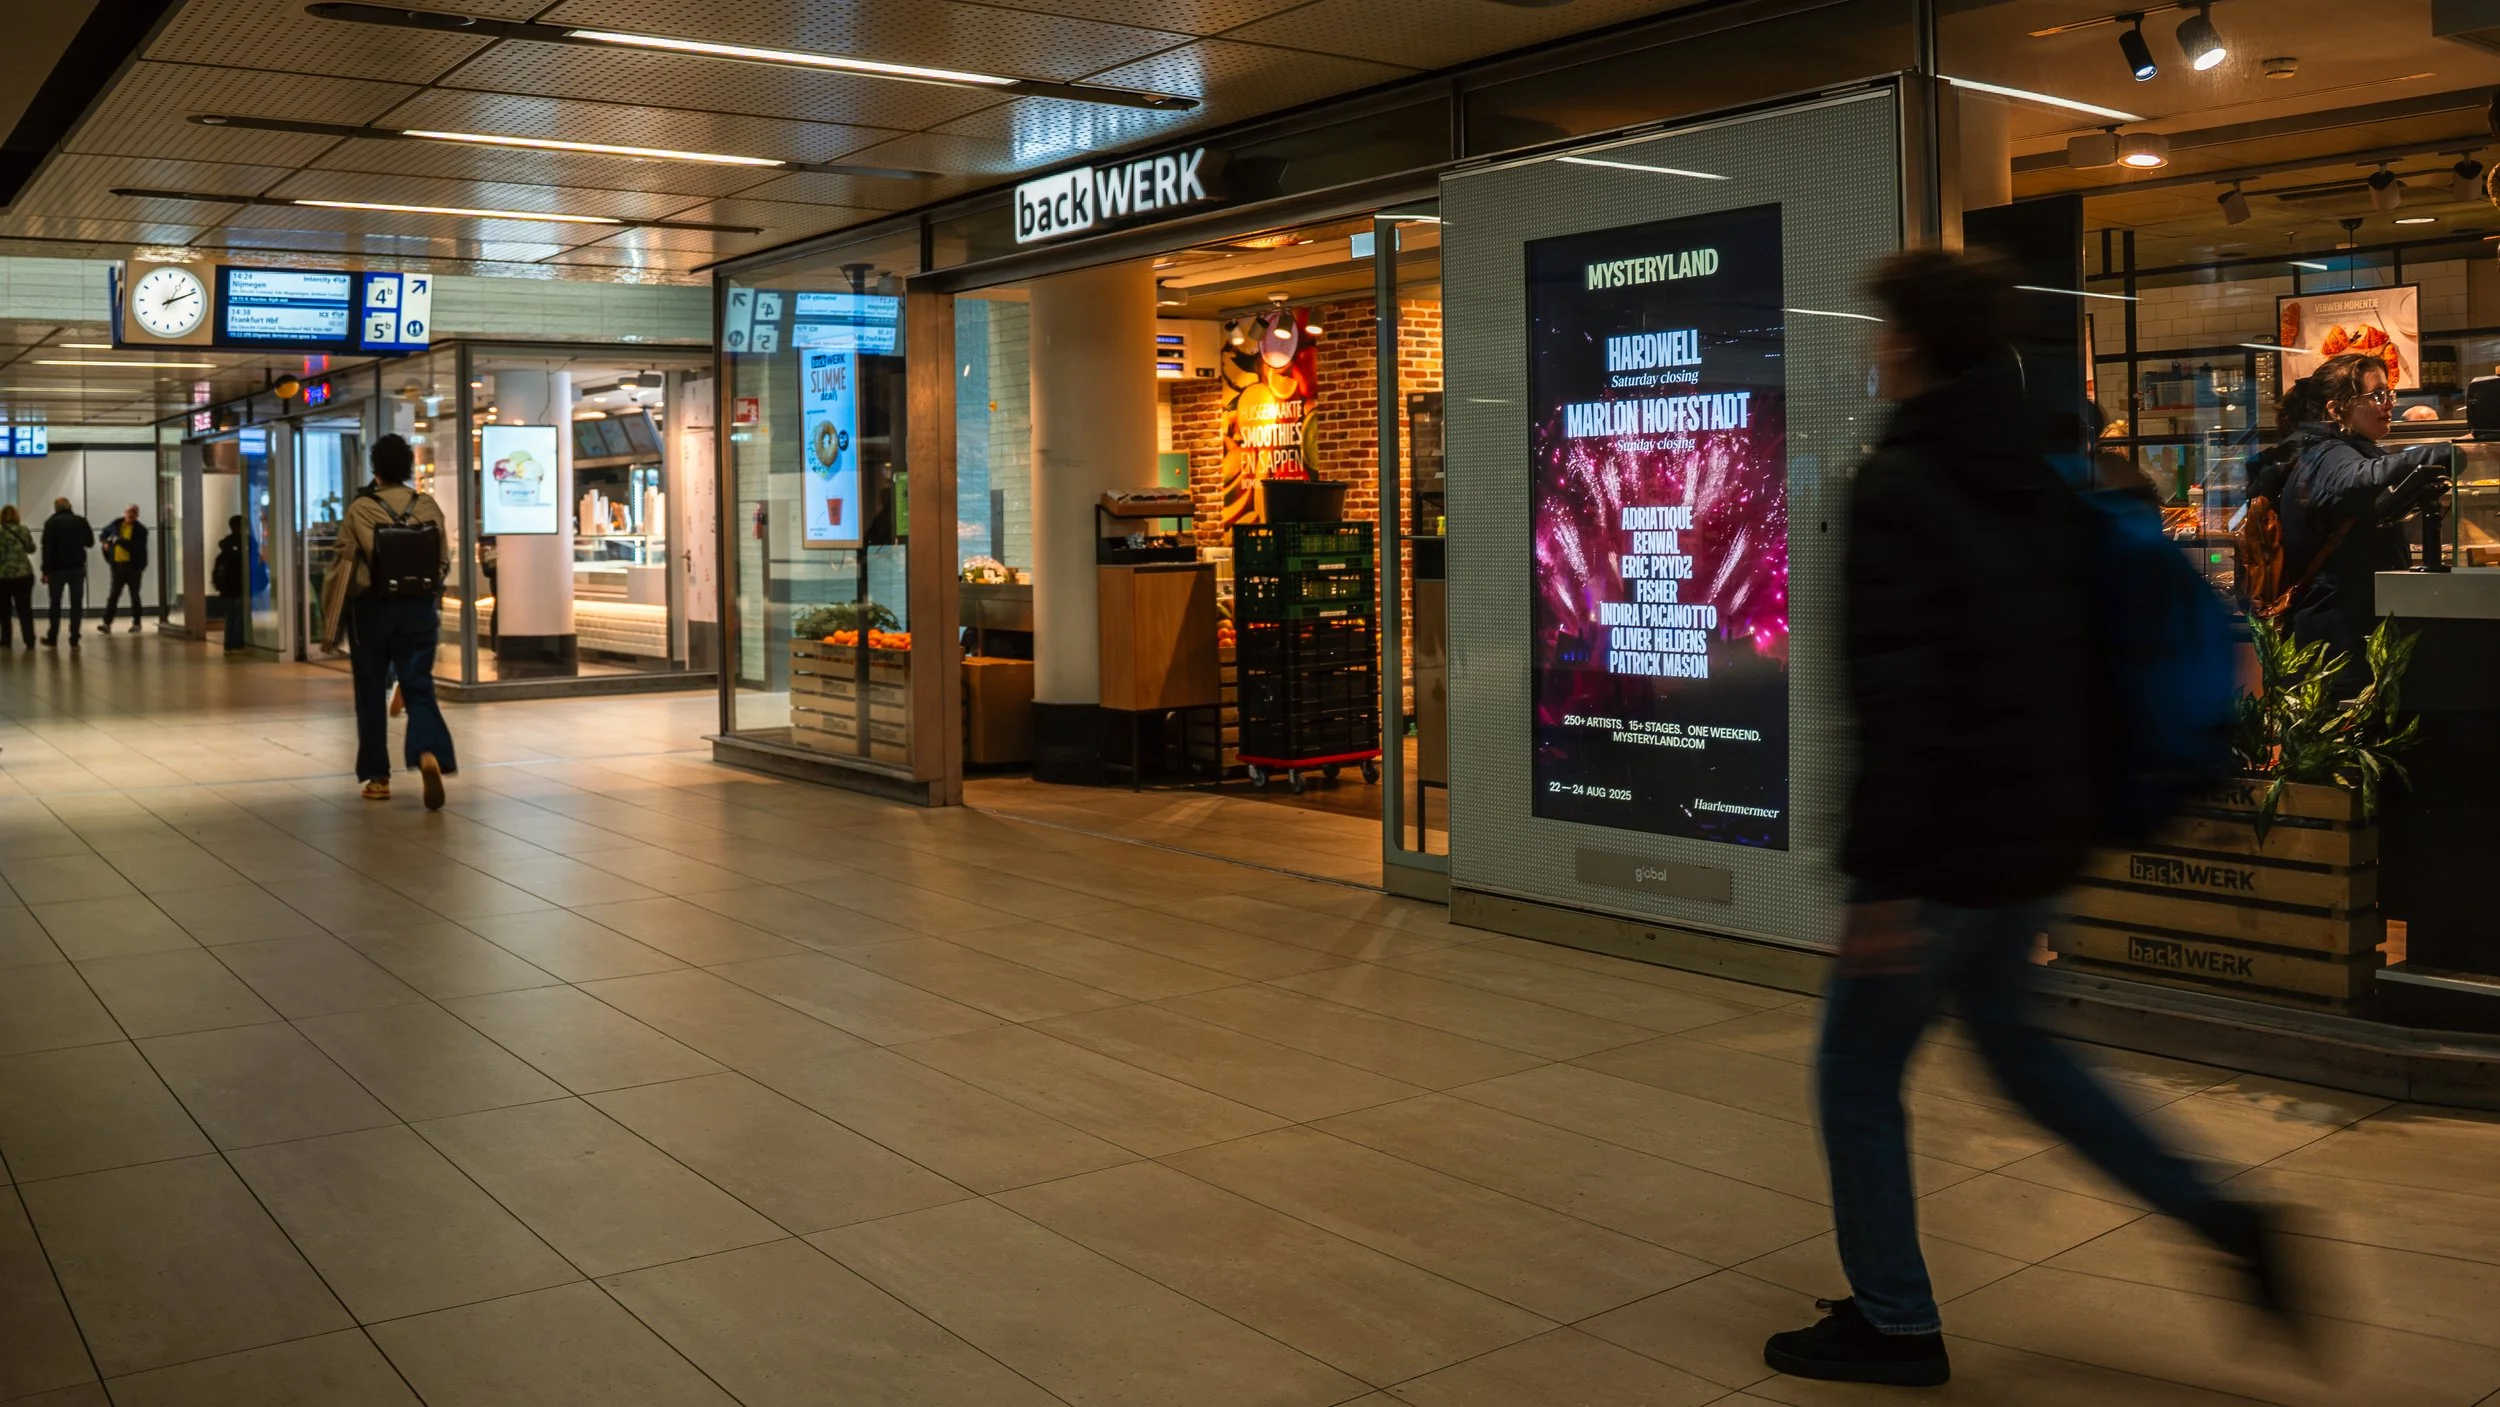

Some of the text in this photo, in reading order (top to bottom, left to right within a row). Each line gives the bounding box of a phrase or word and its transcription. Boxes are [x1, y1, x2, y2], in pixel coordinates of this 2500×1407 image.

[1019, 148, 1206, 238] backWERK
[303, 276, 331, 284] Intercity
[1588, 248, 1719, 290] MYSTERYLAND
[232, 281, 267, 289] Nijmegen
[2315, 302, 2342, 313] VERWEN
[231, 316, 264, 324] Frankfurt
[1608, 328, 1702, 372] HARDWELL
[811, 367, 847, 393] SLIMME
[1611, 369, 1700, 388] Saturday closing
[1567, 392, 1750, 438] MARLON HOFFSTADT
[1241, 422, 1303, 449] SMOOTHIES
[1616, 437, 1696, 452] Sunday closing
[1241, 449, 1304, 475] EN SAPPEN
[1622, 506, 1694, 533] ADRIATIQUE
[1633, 531, 1681, 555] BENWAL
[1622, 556, 1649, 578] ERIC
[1637, 580, 1679, 603] FISHER
[1600, 602, 1640, 627] INDIRA
[1611, 627, 1707, 654] OLIVER HELDENS
[1609, 651, 1709, 679] PATRICK MASON
[1564, 714, 1762, 742] 250+ ARTISTS. 15+ STAGES. ONE WEEKEND.
[1613, 731, 1706, 750] MYSTERYLAND.COM
[1586, 785, 1606, 798] AUG
[1608, 788, 1633, 801] 2025
[1694, 798, 1780, 818] Haarlemmermeer
